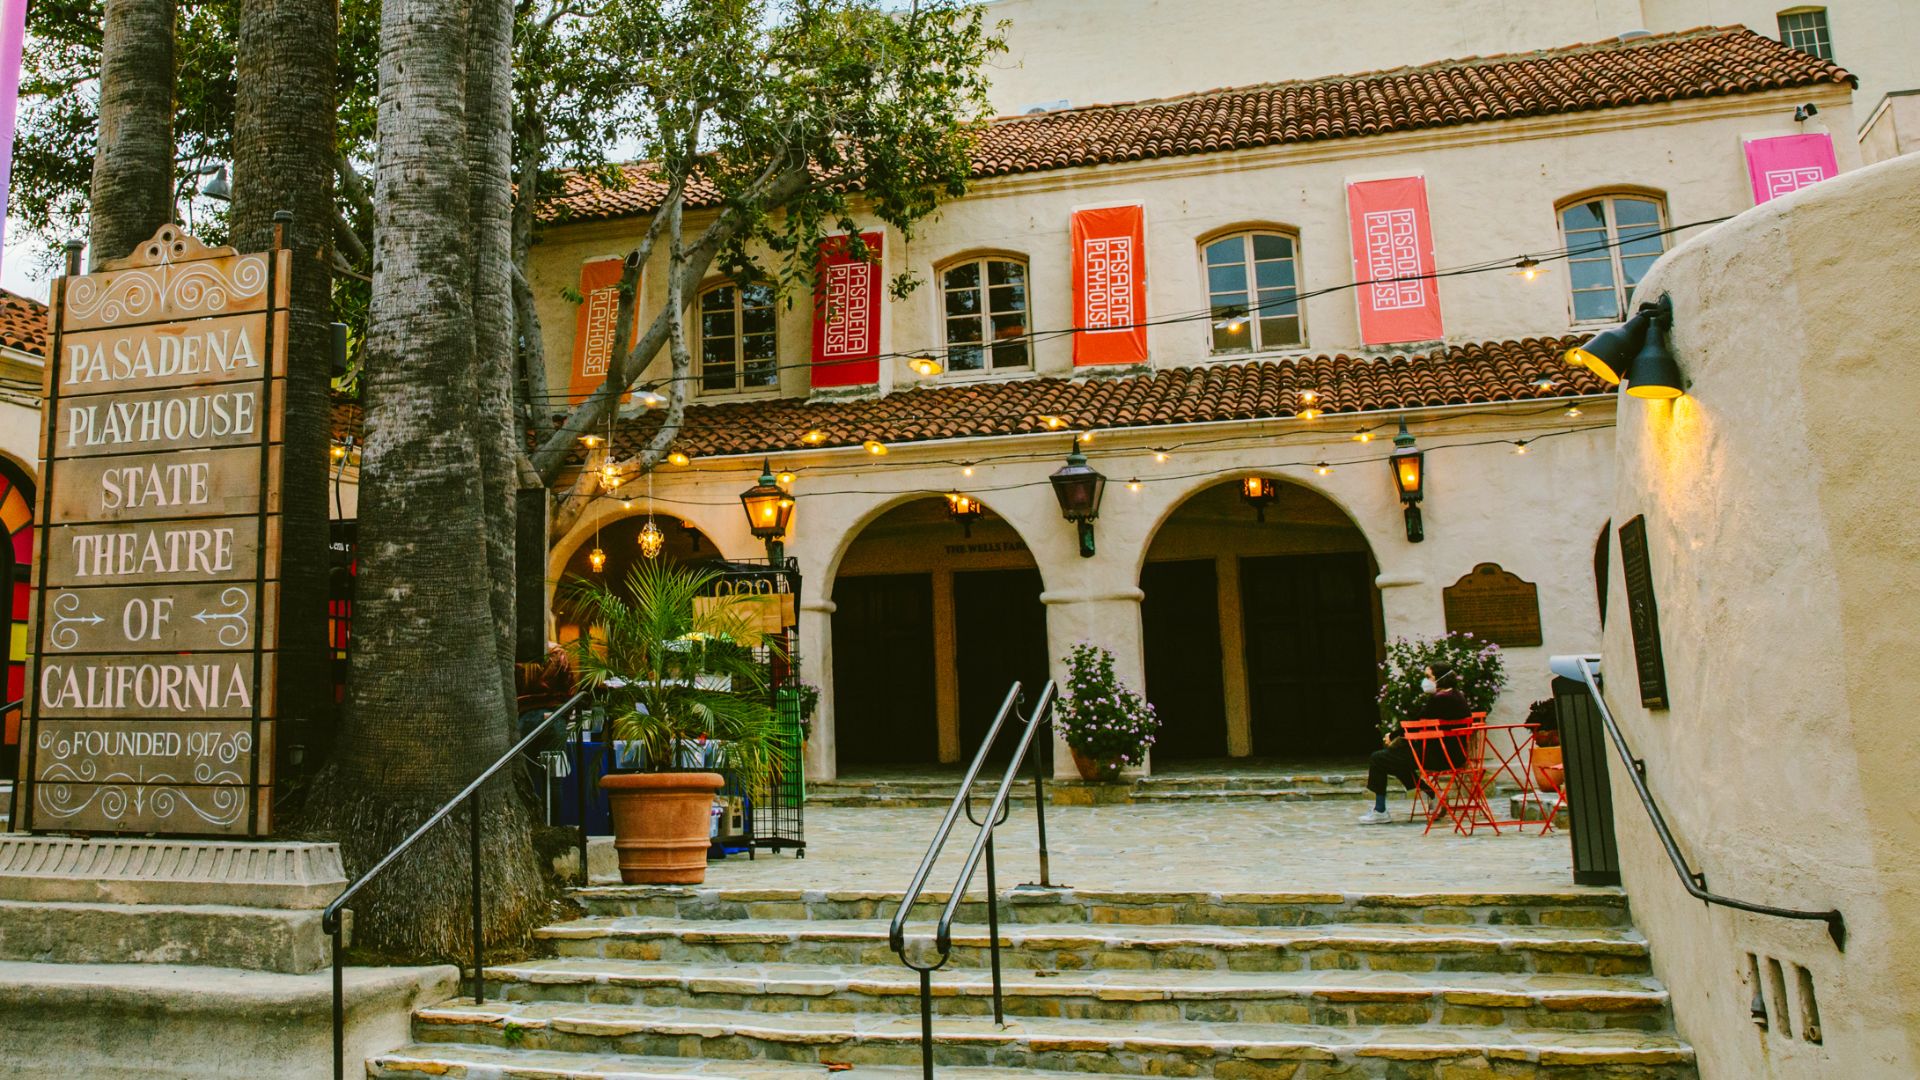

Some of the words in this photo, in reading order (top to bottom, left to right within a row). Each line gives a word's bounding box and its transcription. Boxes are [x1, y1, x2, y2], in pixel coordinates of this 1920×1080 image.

[1088, 243, 1107, 328] PLAYHOUSE
[1111, 240, 1130, 327] PASADENA
[1369, 216, 1396, 305] PLAYHOUSE
[1393, 213, 1420, 304] PASADENA
[587, 292, 608, 374] PLAYHOUSE
[849, 265, 867, 352] PASADENA
[65, 326, 259, 385] PASADENA
[68, 392, 255, 447] PLAYHOUSE
[101, 462, 209, 511] STATE
[72, 528, 234, 577] THEATRE
[122, 598, 174, 642] OF
[41, 662, 252, 712] CALIFORNIA
[72, 731, 181, 757] FOUNDED
[186, 731, 222, 763] 1917
